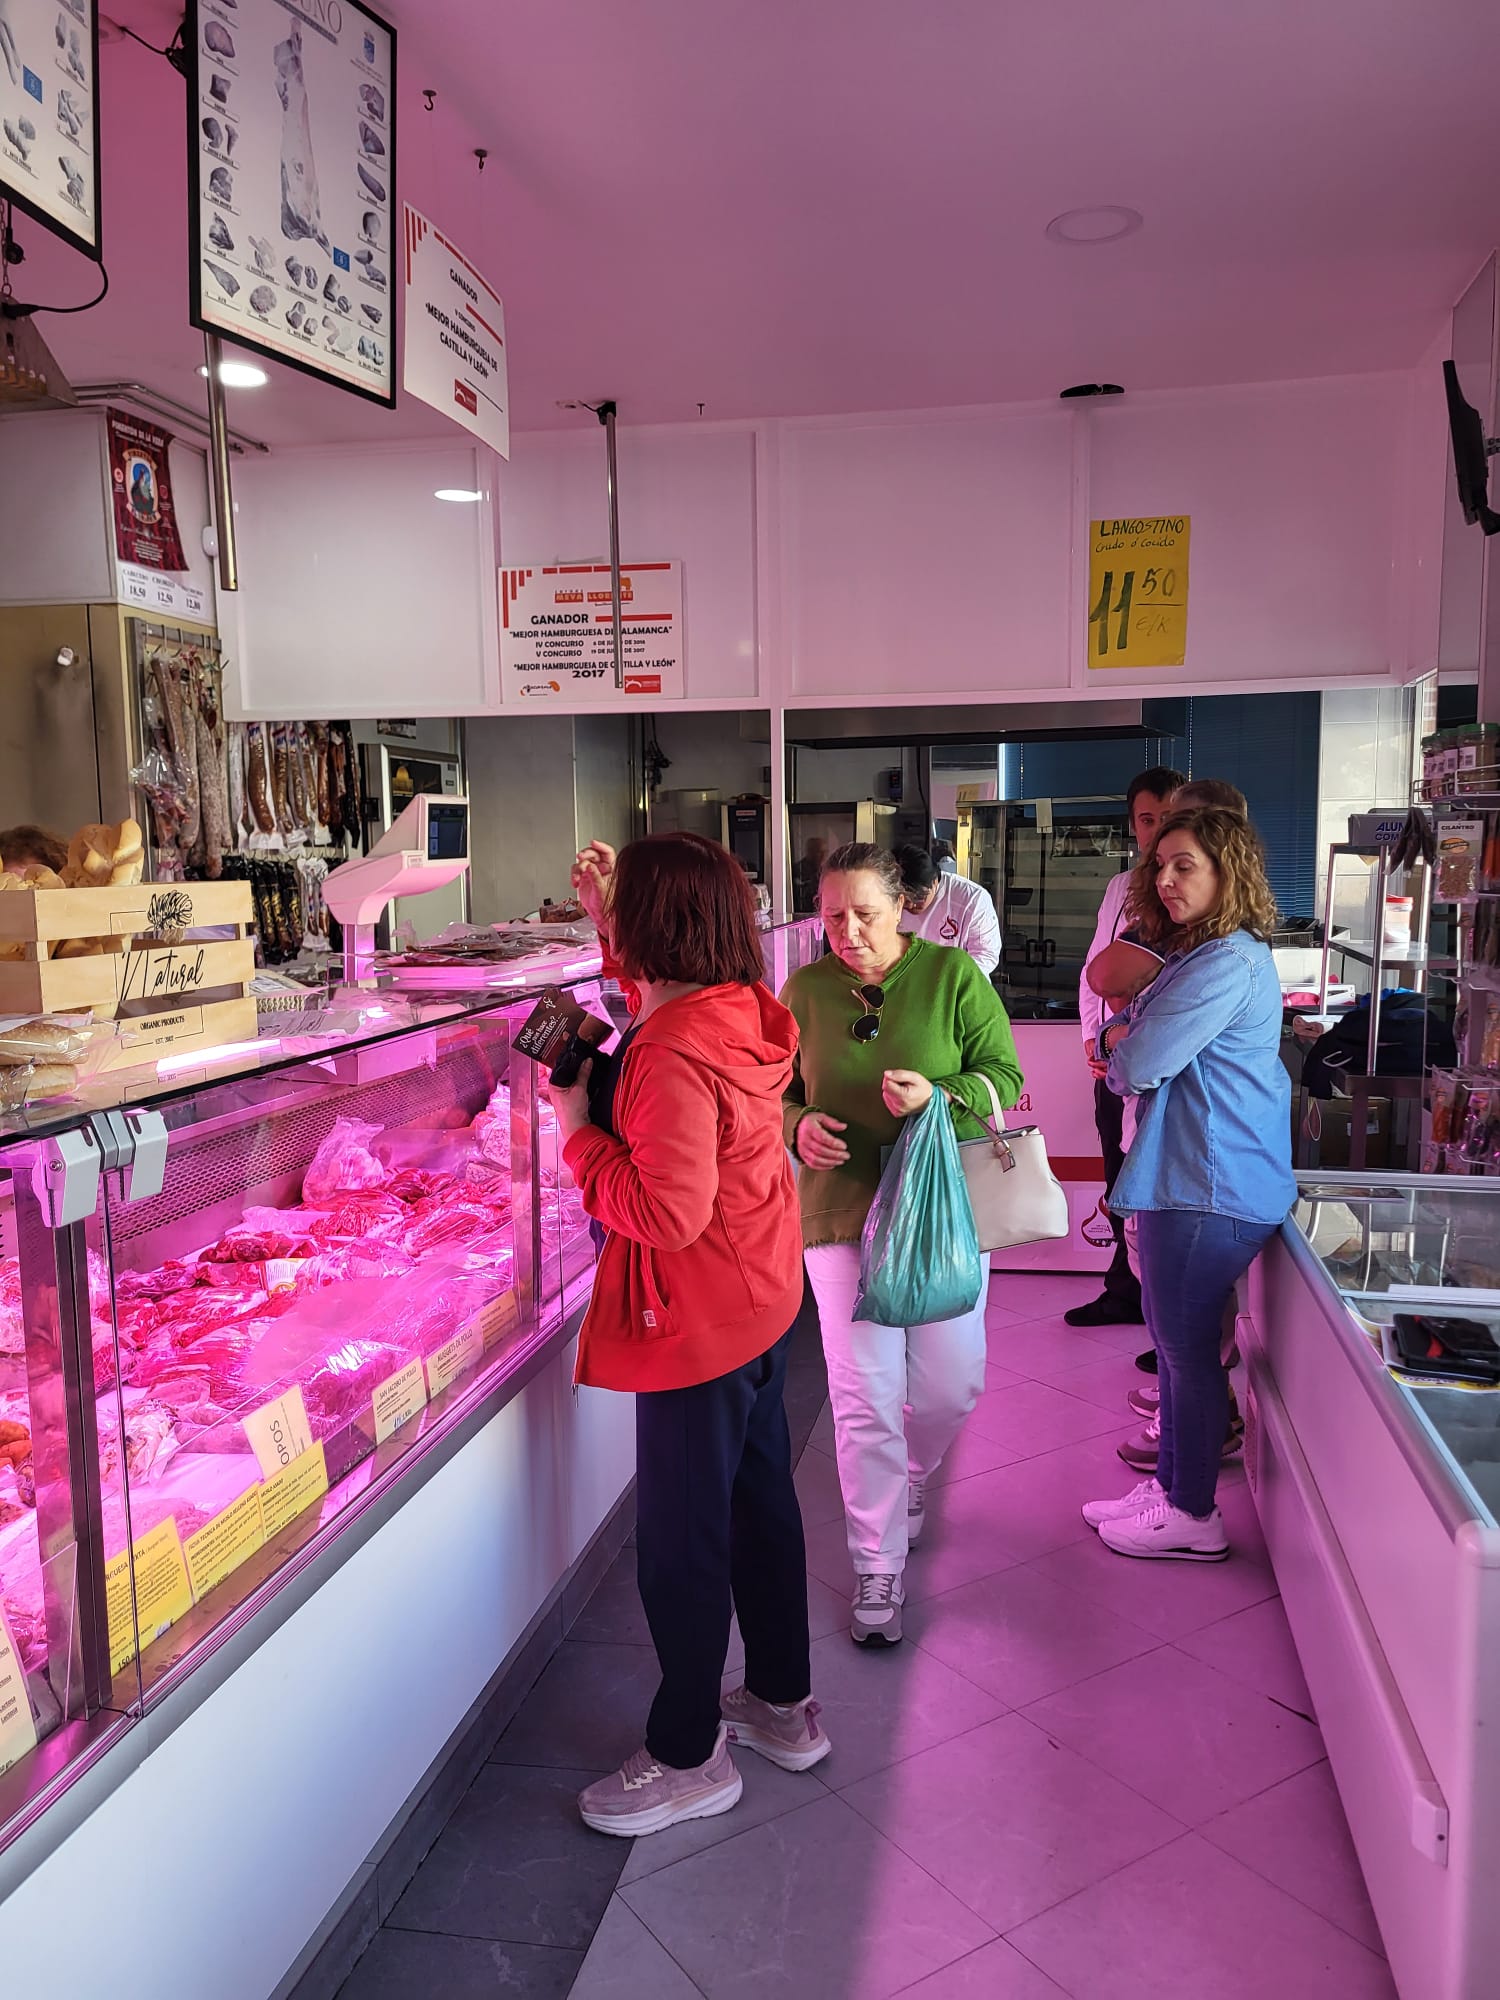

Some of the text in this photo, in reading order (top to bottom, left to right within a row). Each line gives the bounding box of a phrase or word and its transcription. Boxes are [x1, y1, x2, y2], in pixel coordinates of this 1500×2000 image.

[449, 268, 478, 304] GANADOR
[440, 331, 468, 362] CASTILLA
[450, 319, 491, 365] HAMBURGUESA
[491, 357, 498, 373] DE
[1100, 519, 1184, 537] LANGOSTINO
[531, 614, 589, 625] GANADOR
[1089, 571, 1135, 655] 11
[541, 628, 602, 638] HAMBURGUESA
[621, 626, 672, 635] ALAMANCA"
[536, 641, 543, 649] IV
[544, 640, 584, 648] CONCURSO
[541, 662, 597, 670] HAMBURGUESA
[599, 661, 609, 669] DE
[610, 660, 643, 669] CTILLA
[645, 660, 651, 668] Y
[572, 669, 605, 678] 2017
[119, 948, 204, 1001] Natural
[140, 1015, 185, 1031] ORGANIC PRODUCTS
[519, 1027, 535, 1049] ¿Qué
